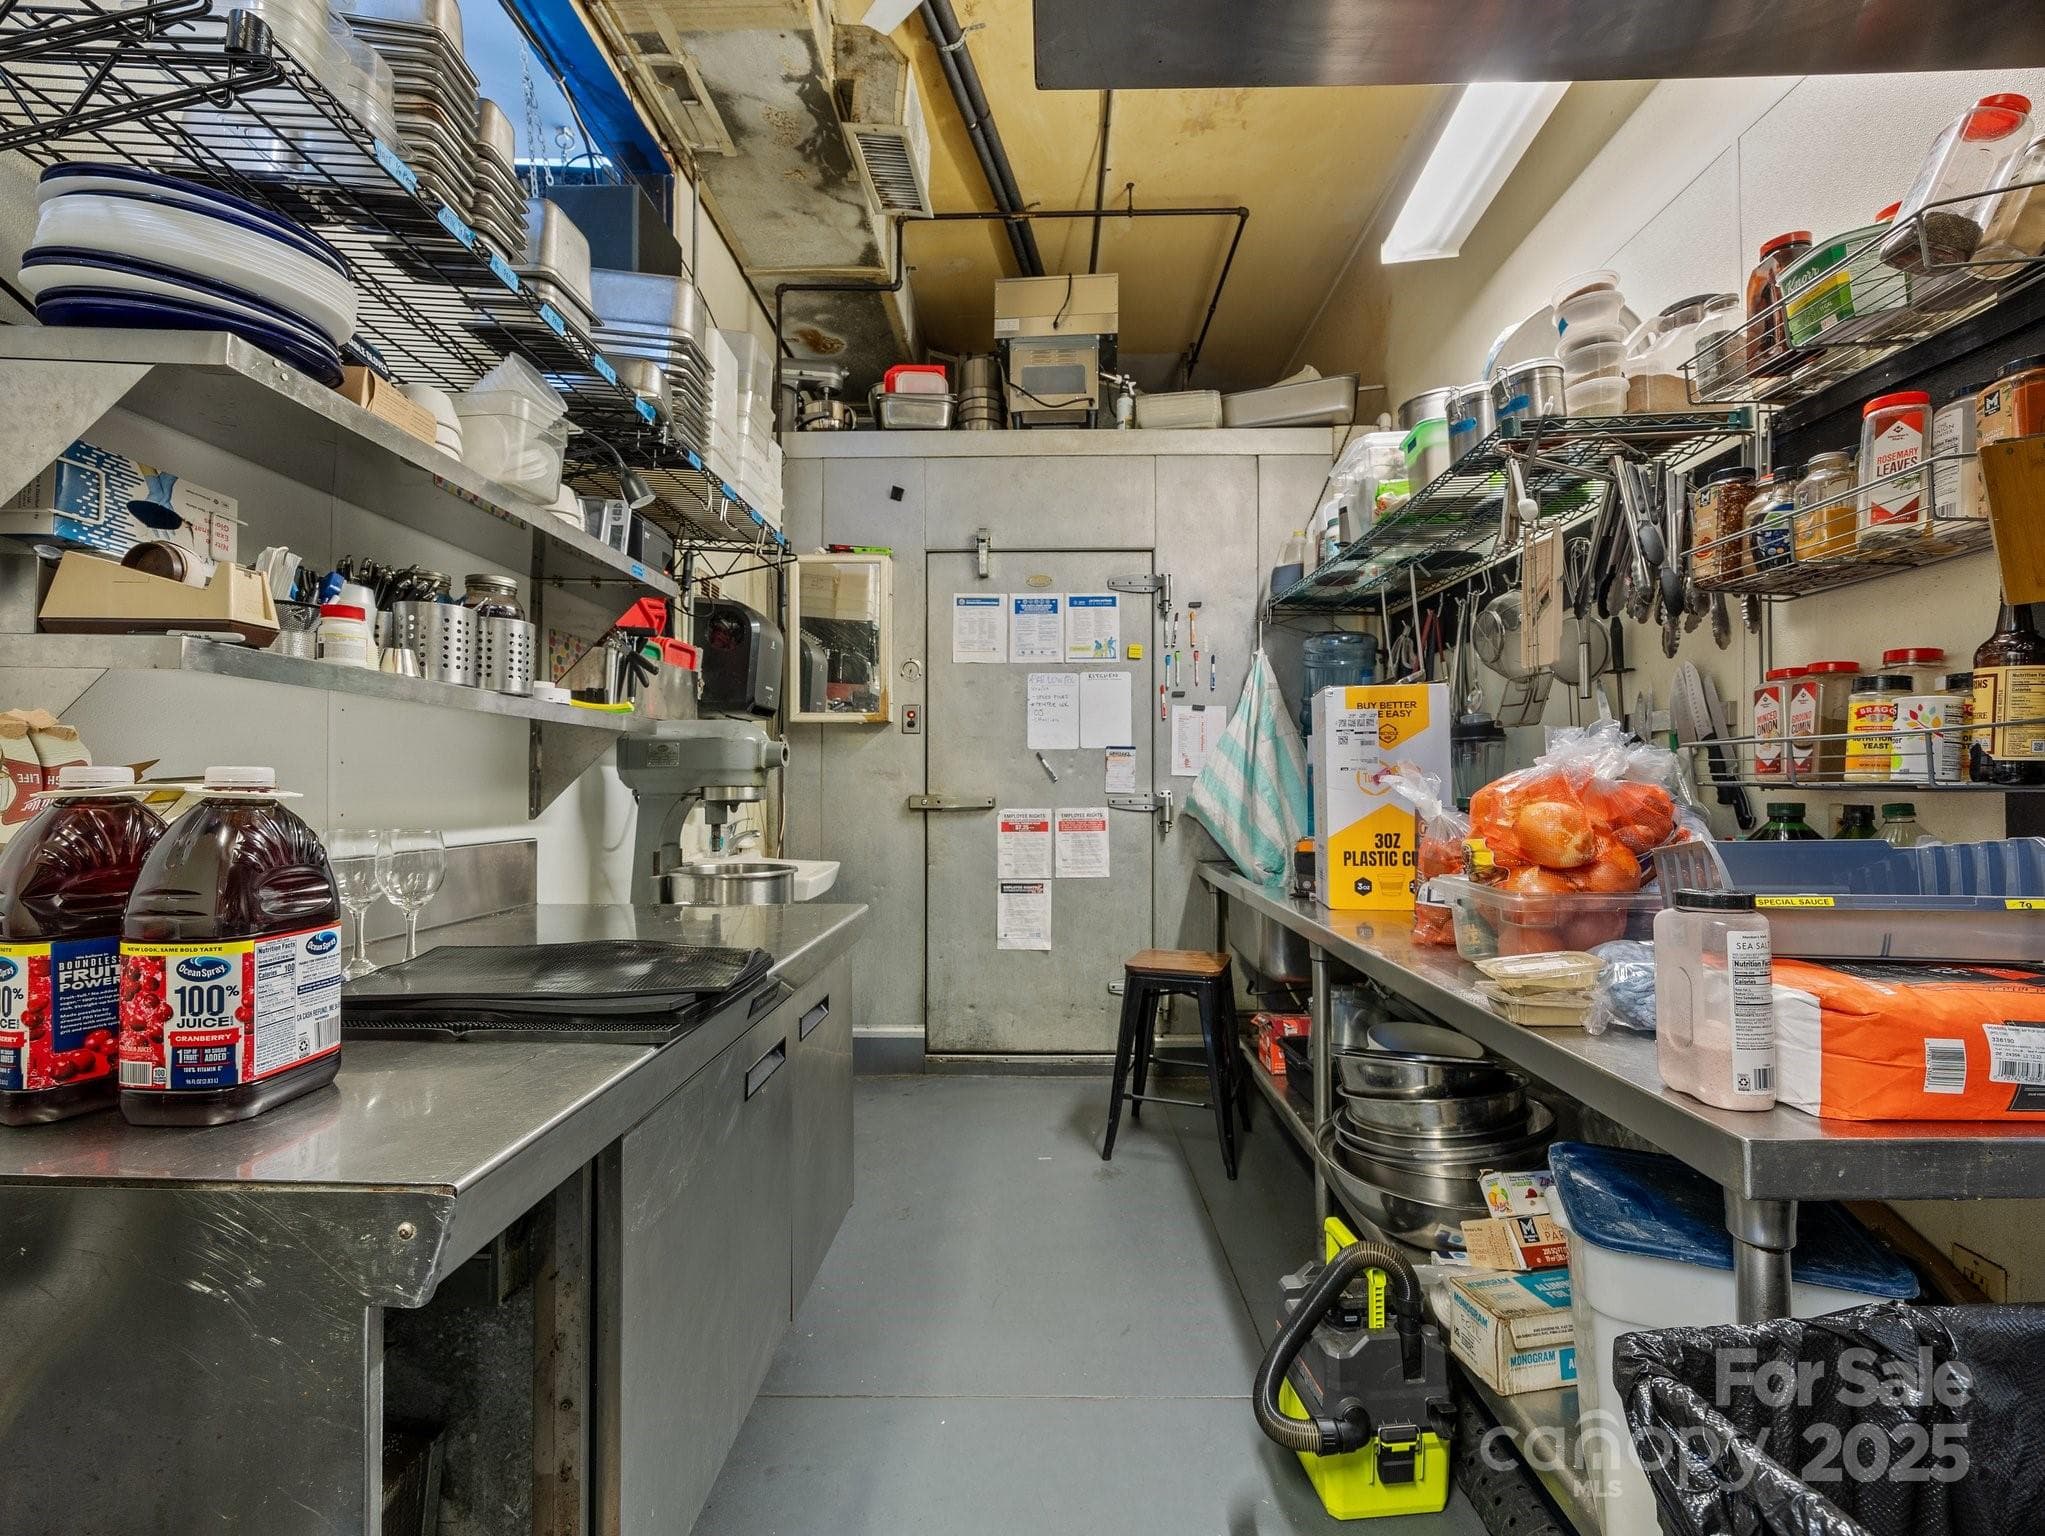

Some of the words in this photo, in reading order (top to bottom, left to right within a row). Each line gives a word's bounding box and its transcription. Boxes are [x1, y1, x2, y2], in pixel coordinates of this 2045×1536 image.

[1877, 447, 1919, 464] ROSEMARY
[1877, 456, 1918, 477] LEAVES
[1357, 702, 1379, 710] BUY
[1380, 701, 1417, 709] BETTER
[1386, 710, 1412, 718] EASY
[1757, 720, 1778, 736] ONION
[1791, 720, 1811, 734] CUMIN
[17, 773, 40, 784] LIFE
[1344, 851, 1398, 867] PLASTIC
[258, 944, 281, 954] Nutrition
[281, 942, 296, 950] Facts
[1736, 942, 1754, 950] SEA
[58, 955, 120, 971] BOUNDLES
[258, 970, 277, 978] Calories
[285, 963, 295, 972] 100
[59, 964, 120, 983] FRUIT
[179, 964, 201, 977] Ocean
[201, 964, 226, 978] Spray
[59, 976, 120, 992] POWER
[174, 985, 240, 1017] 100%
[176, 1015, 230, 1028] JUICE
[175, 1033, 232, 1042] CRANBERRY
[177, 1049, 182, 1064] 1
[204, 1053, 227, 1062] ADDED
[1453, 1291, 1488, 1329] MONOGRAM
[1510, 1350, 1556, 1367] MONOGRAM
